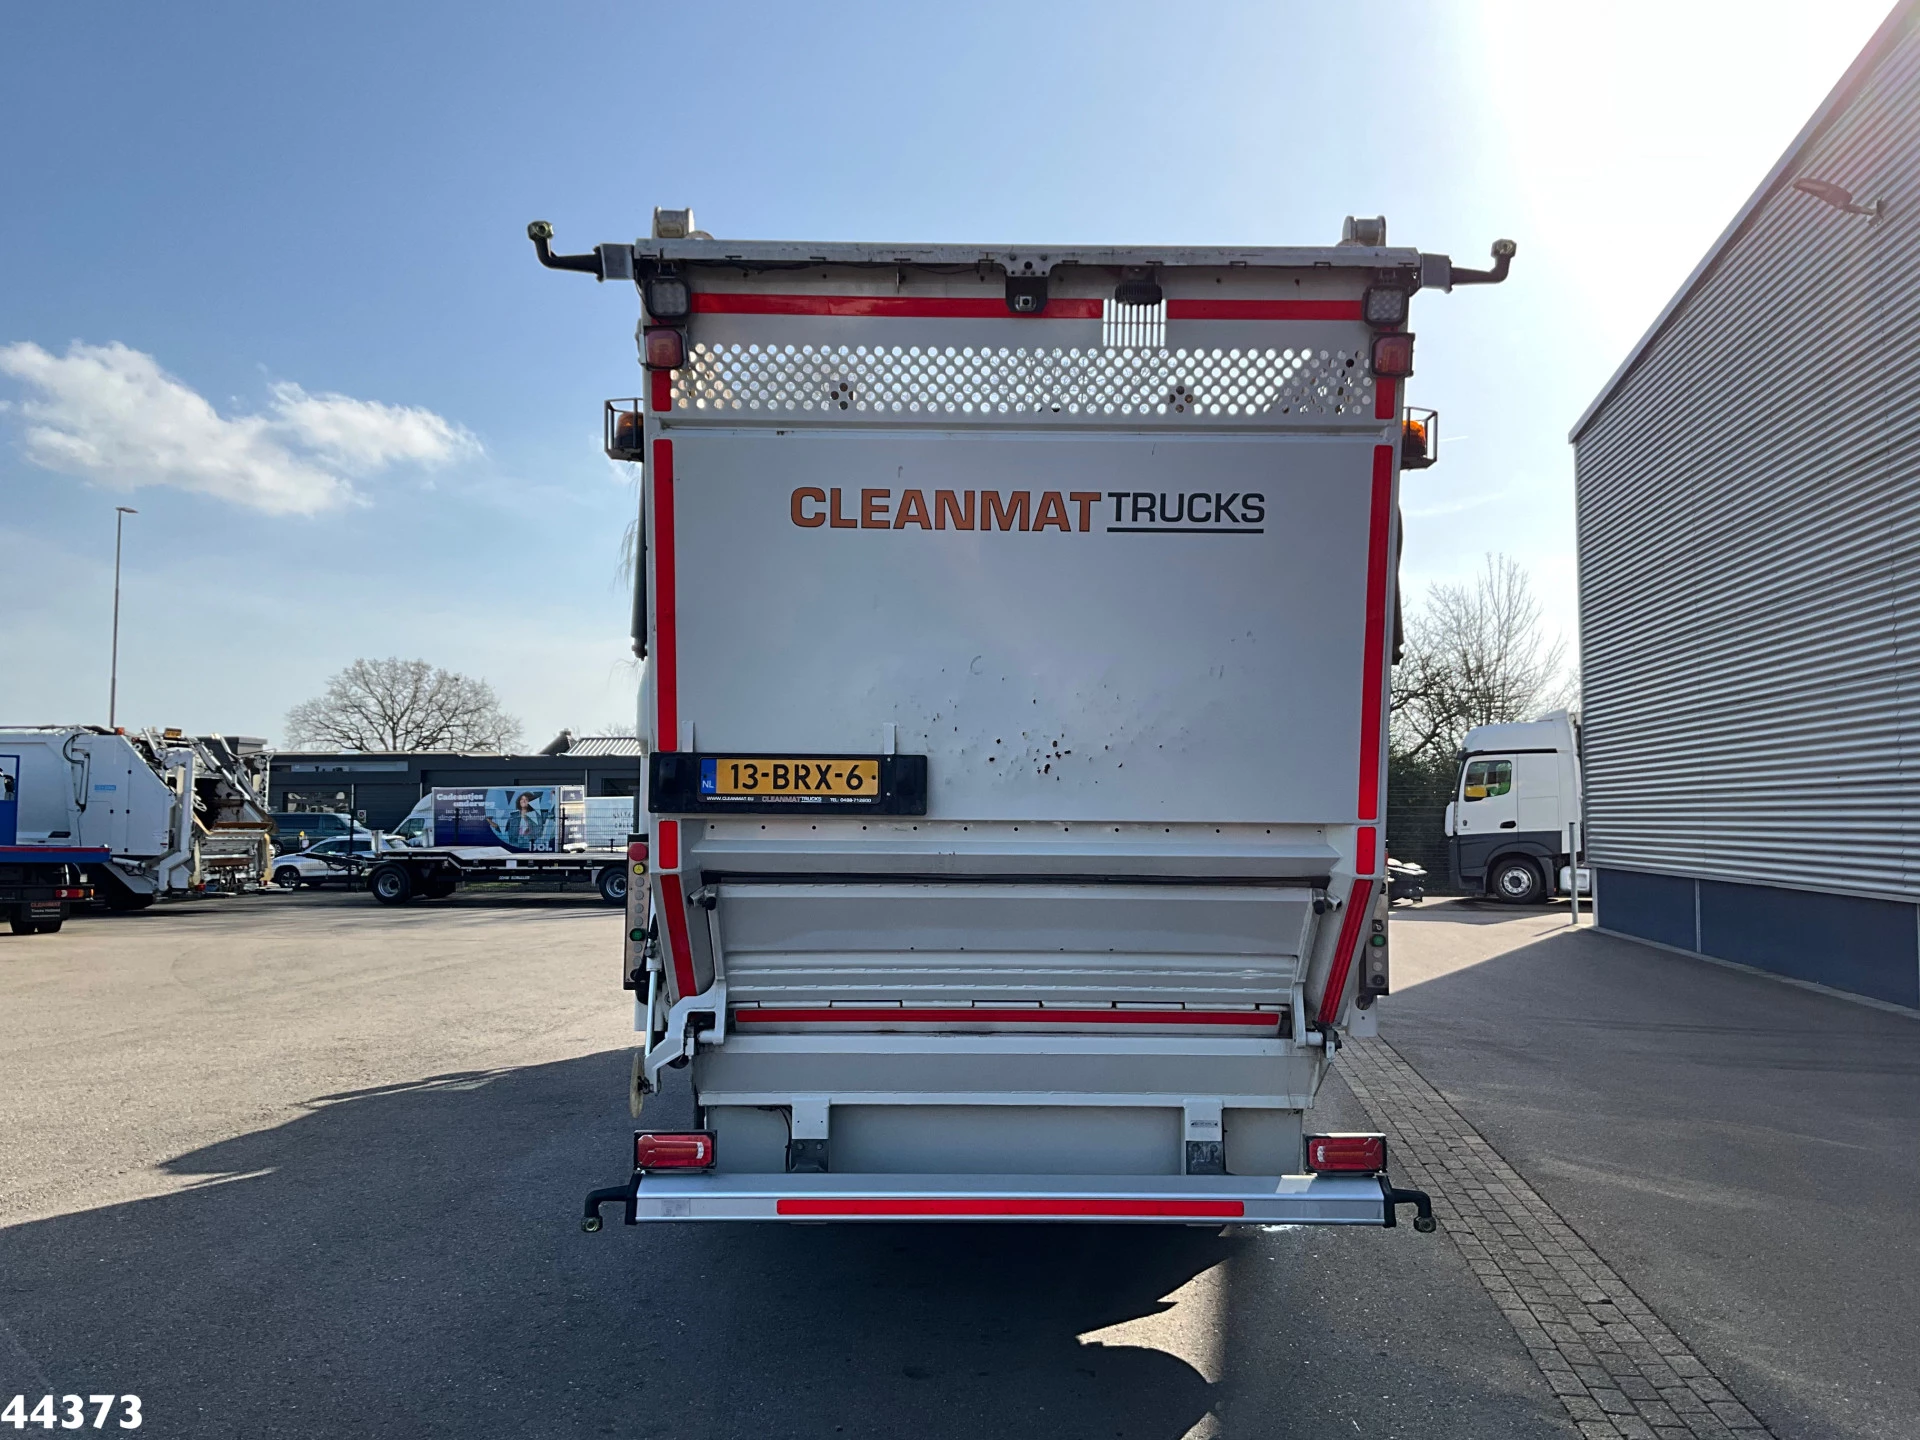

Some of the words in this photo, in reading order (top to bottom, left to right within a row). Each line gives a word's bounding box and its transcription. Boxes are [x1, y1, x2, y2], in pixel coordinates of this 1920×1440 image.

[790, 486, 1102, 533] CLEANMAT
[1107, 491, 1266, 525] TRUCKS
[702, 780, 715, 789] NL
[730, 763, 863, 791] 13-BRX-6
[761, 795, 801, 803] CLEANMAT
